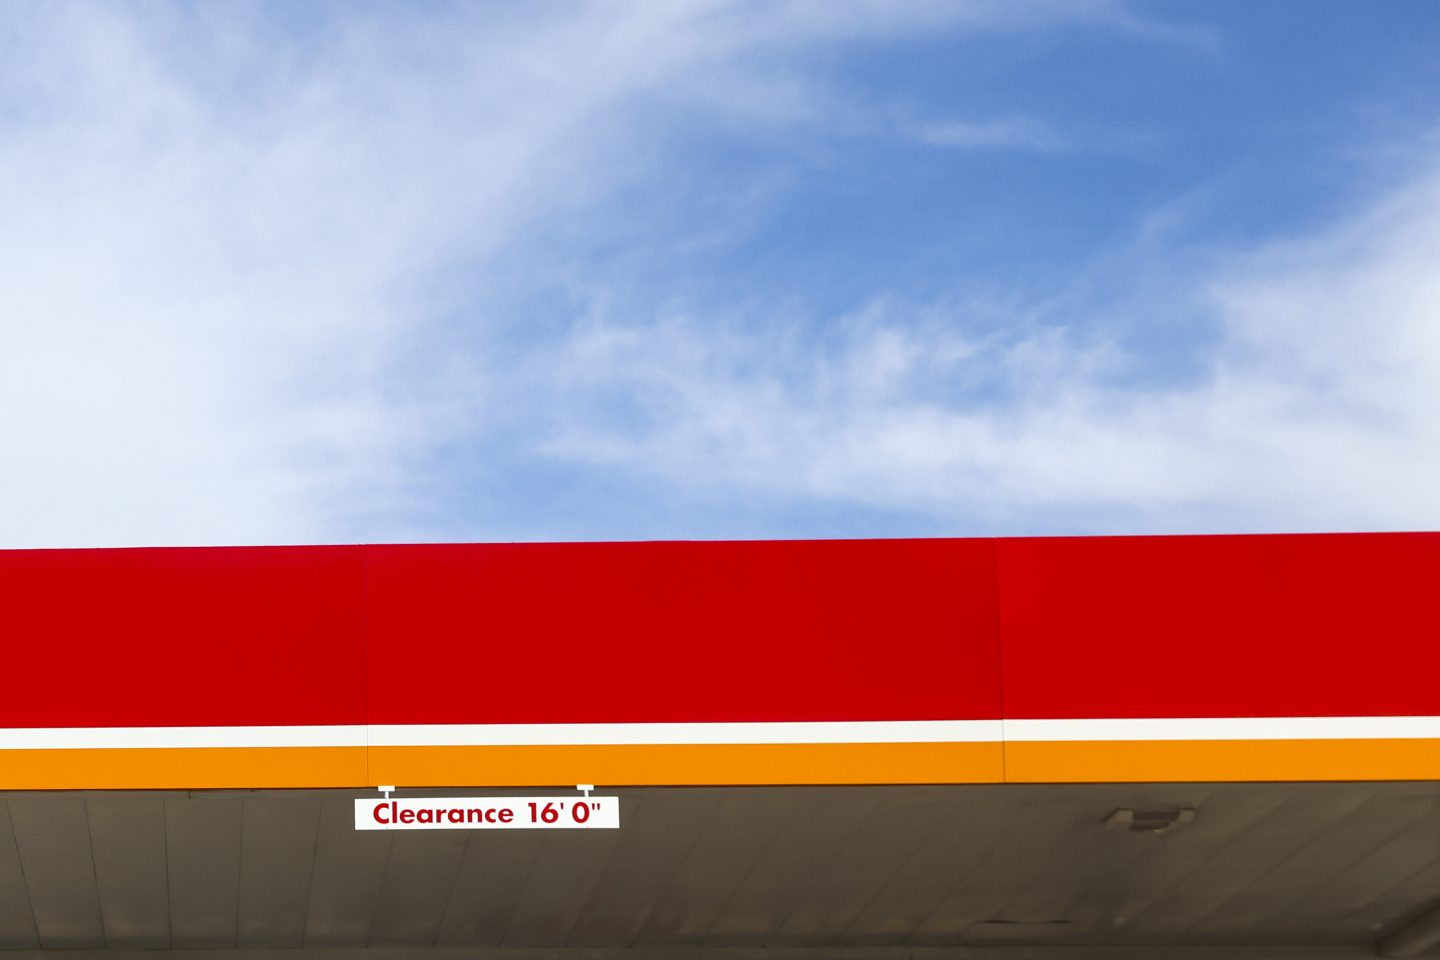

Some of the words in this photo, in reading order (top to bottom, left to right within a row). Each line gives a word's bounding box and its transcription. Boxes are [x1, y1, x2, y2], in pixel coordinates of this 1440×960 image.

[372, 801, 514, 824] Clearance
[527, 802, 564, 823] 16'
[571, 801, 600, 823] 0"
